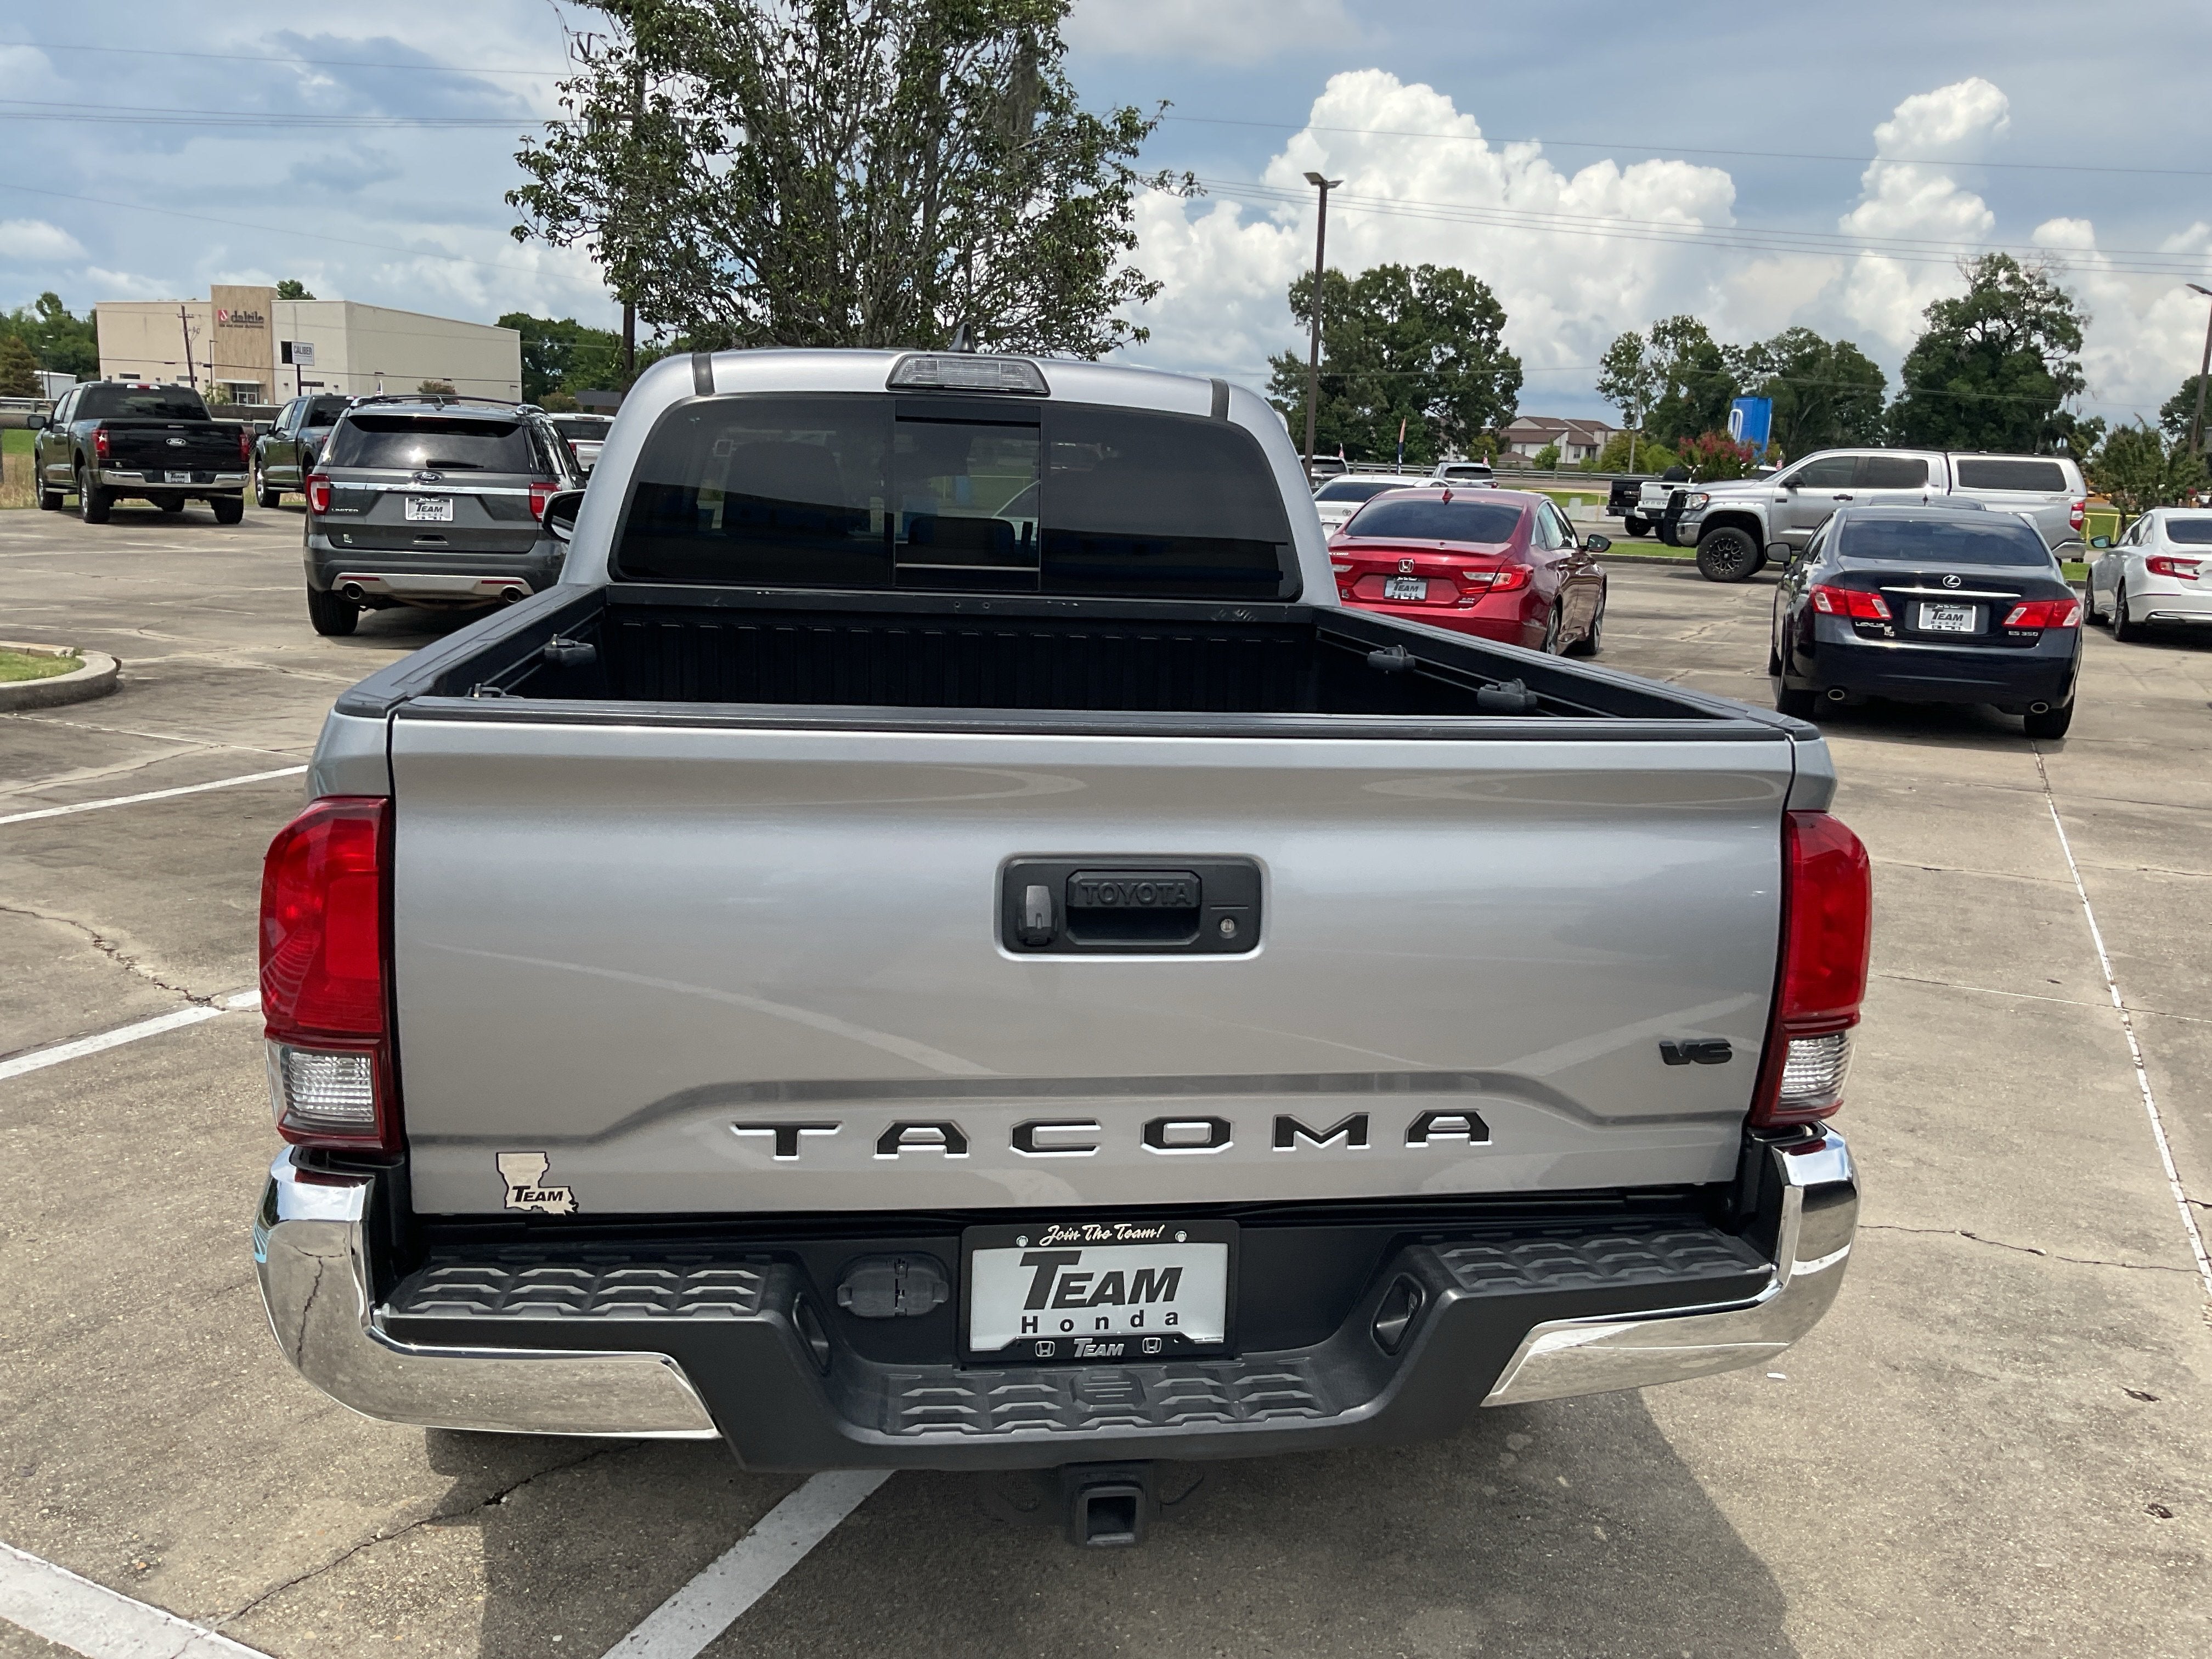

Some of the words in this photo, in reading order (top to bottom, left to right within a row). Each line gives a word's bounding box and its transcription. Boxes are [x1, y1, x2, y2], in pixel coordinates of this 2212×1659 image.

[230, 311, 264, 323] daltile
[294, 345, 312, 356] CALIBER
[416, 502, 443, 513] TEAM
[1393, 582, 1419, 592] TEAM
[1932, 608, 1964, 622] TEAM
[1080, 882, 1192, 905] TOYOTA
[1658, 1038, 1733, 1065] V6
[730, 1108, 1493, 1160] TACOMA
[512, 1185, 563, 1203] TEAM
[1039, 1224, 1081, 1246] Join
[1081, 1224, 1113, 1241] The
[1114, 1223, 1165, 1240] Team!
[1019, 1250, 1183, 1311] TEAM
[1020, 1309, 1179, 1334] Honda
[1073, 1338, 1125, 1358] TEAM
